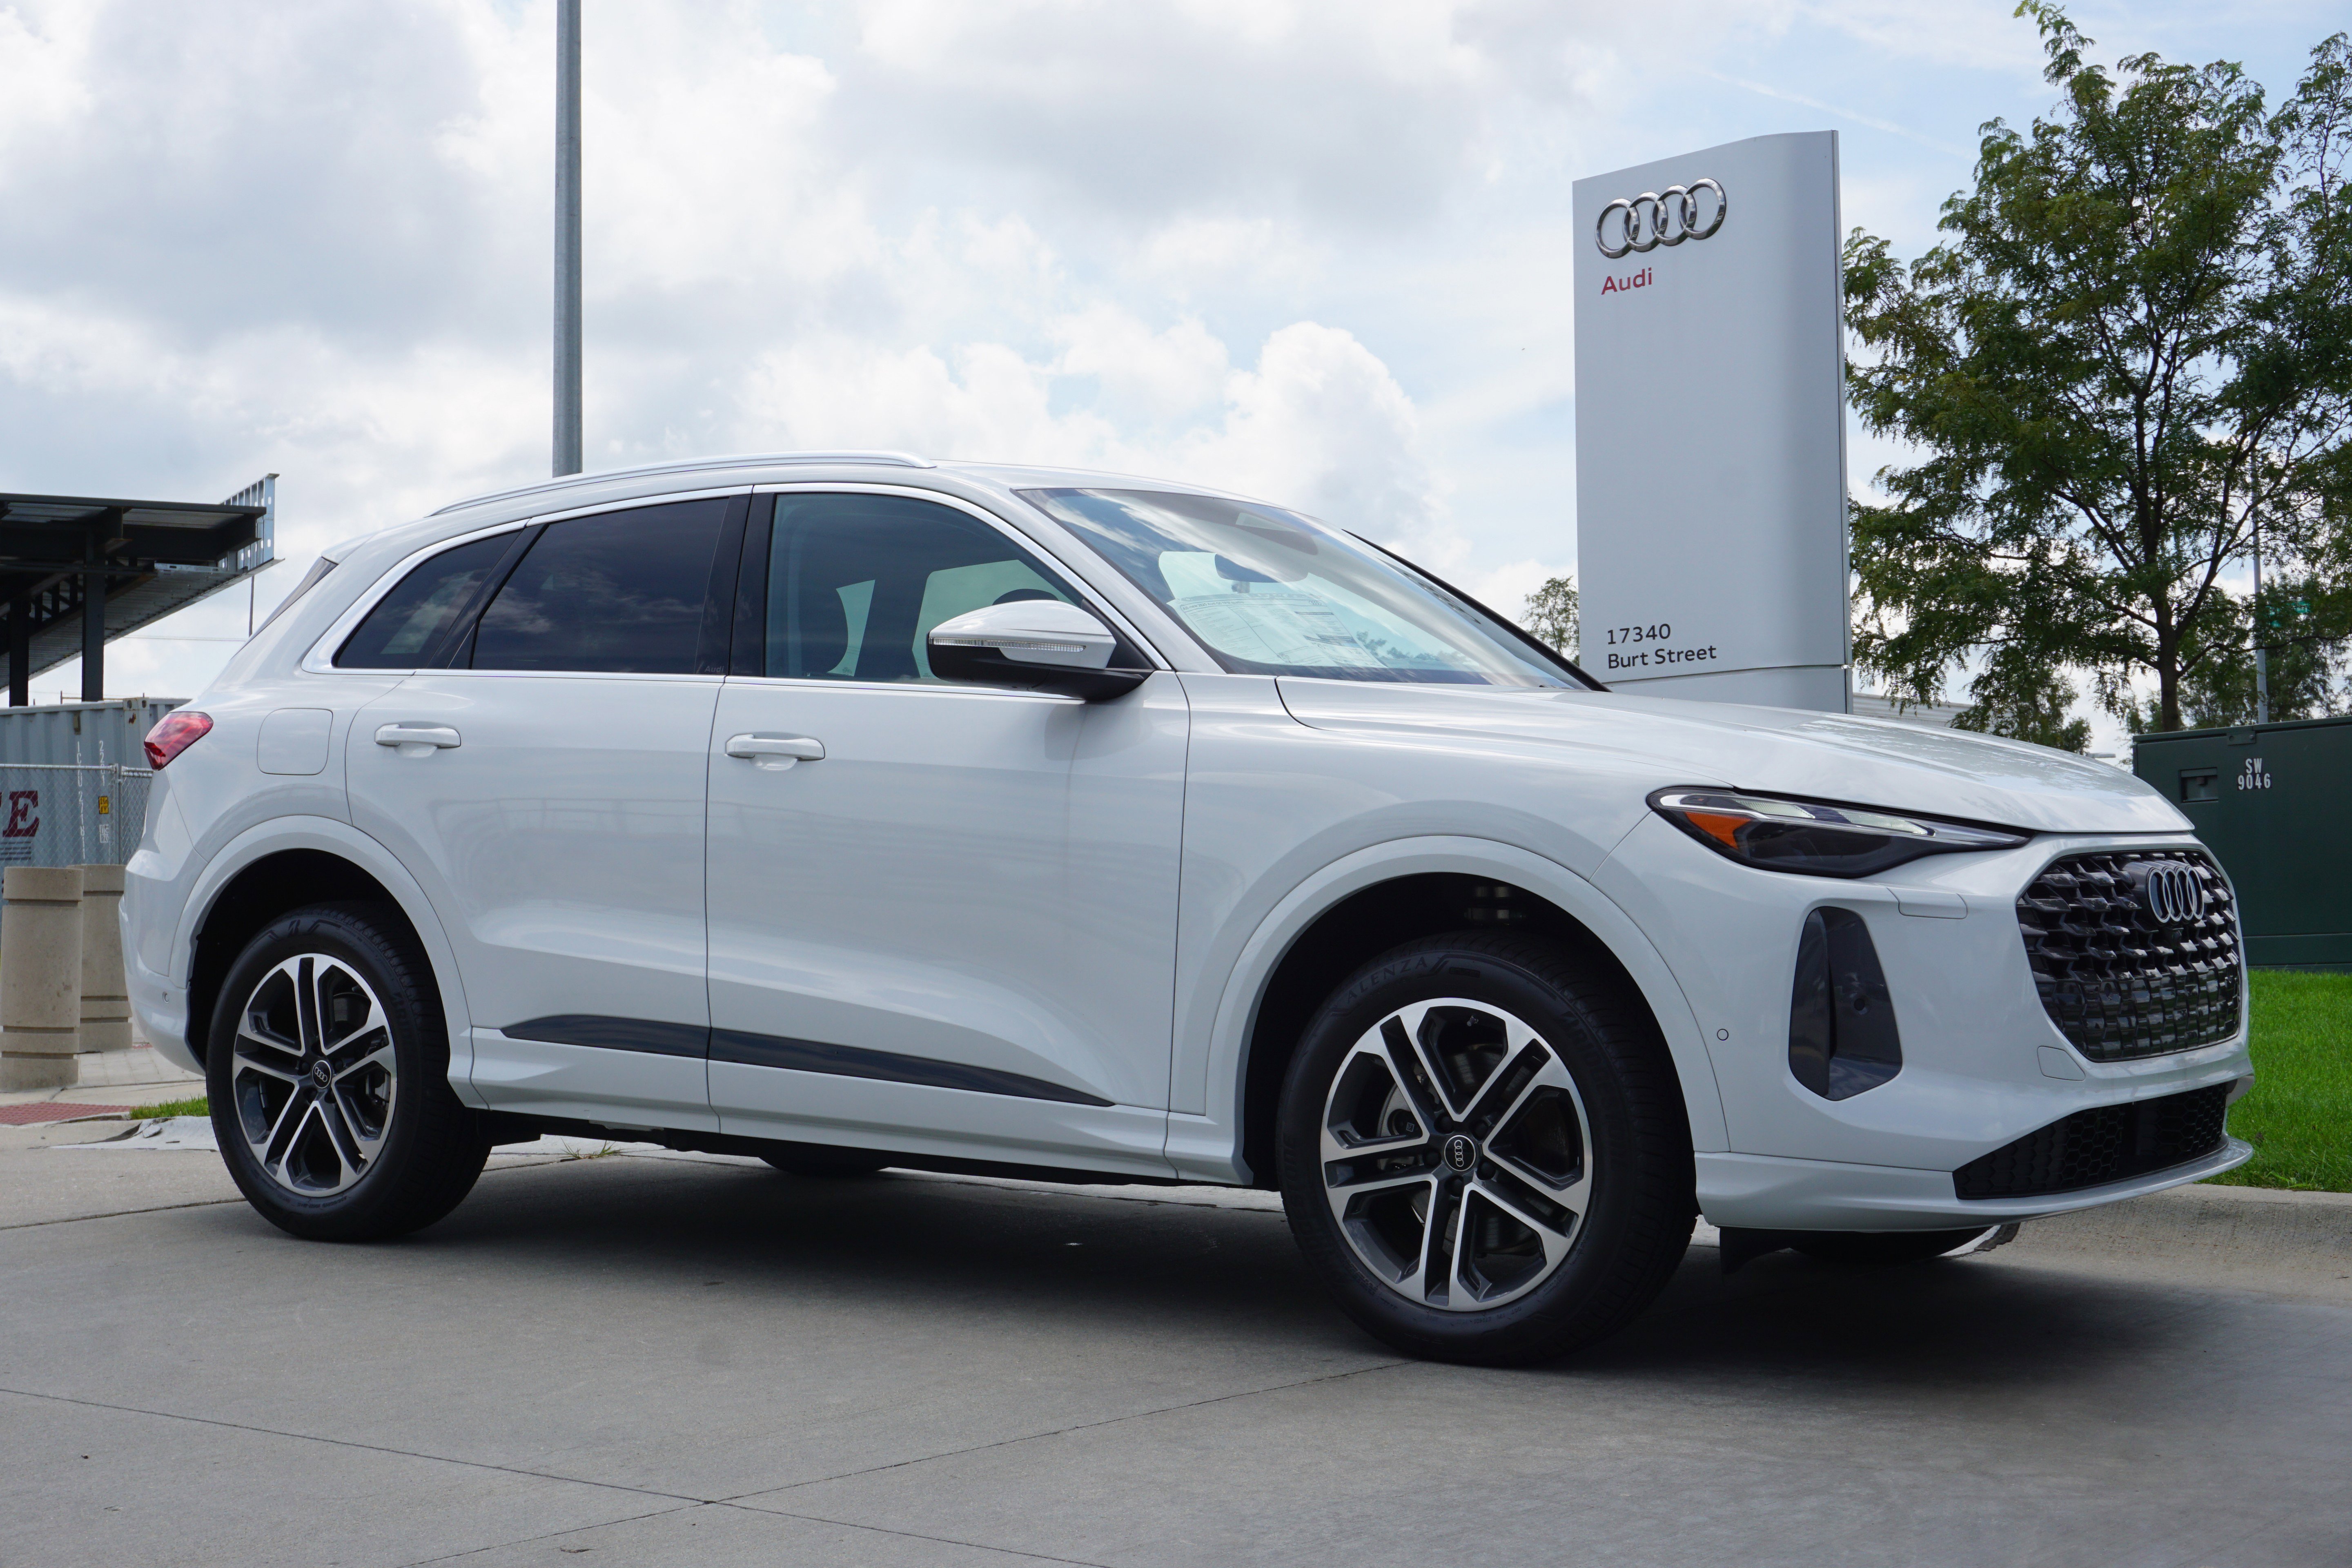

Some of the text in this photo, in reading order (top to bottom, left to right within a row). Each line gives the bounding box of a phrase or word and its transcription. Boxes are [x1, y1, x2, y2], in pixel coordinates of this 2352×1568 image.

[1601, 267, 1652, 295] Audi
[1607, 624, 1671, 644] 17340
[1608, 645, 1716, 668] Burt Street
[2245, 758, 2262, 774] SW
[2238, 773, 2271, 791] 9046
[1347, 956, 1428, 1003] ALENZA
